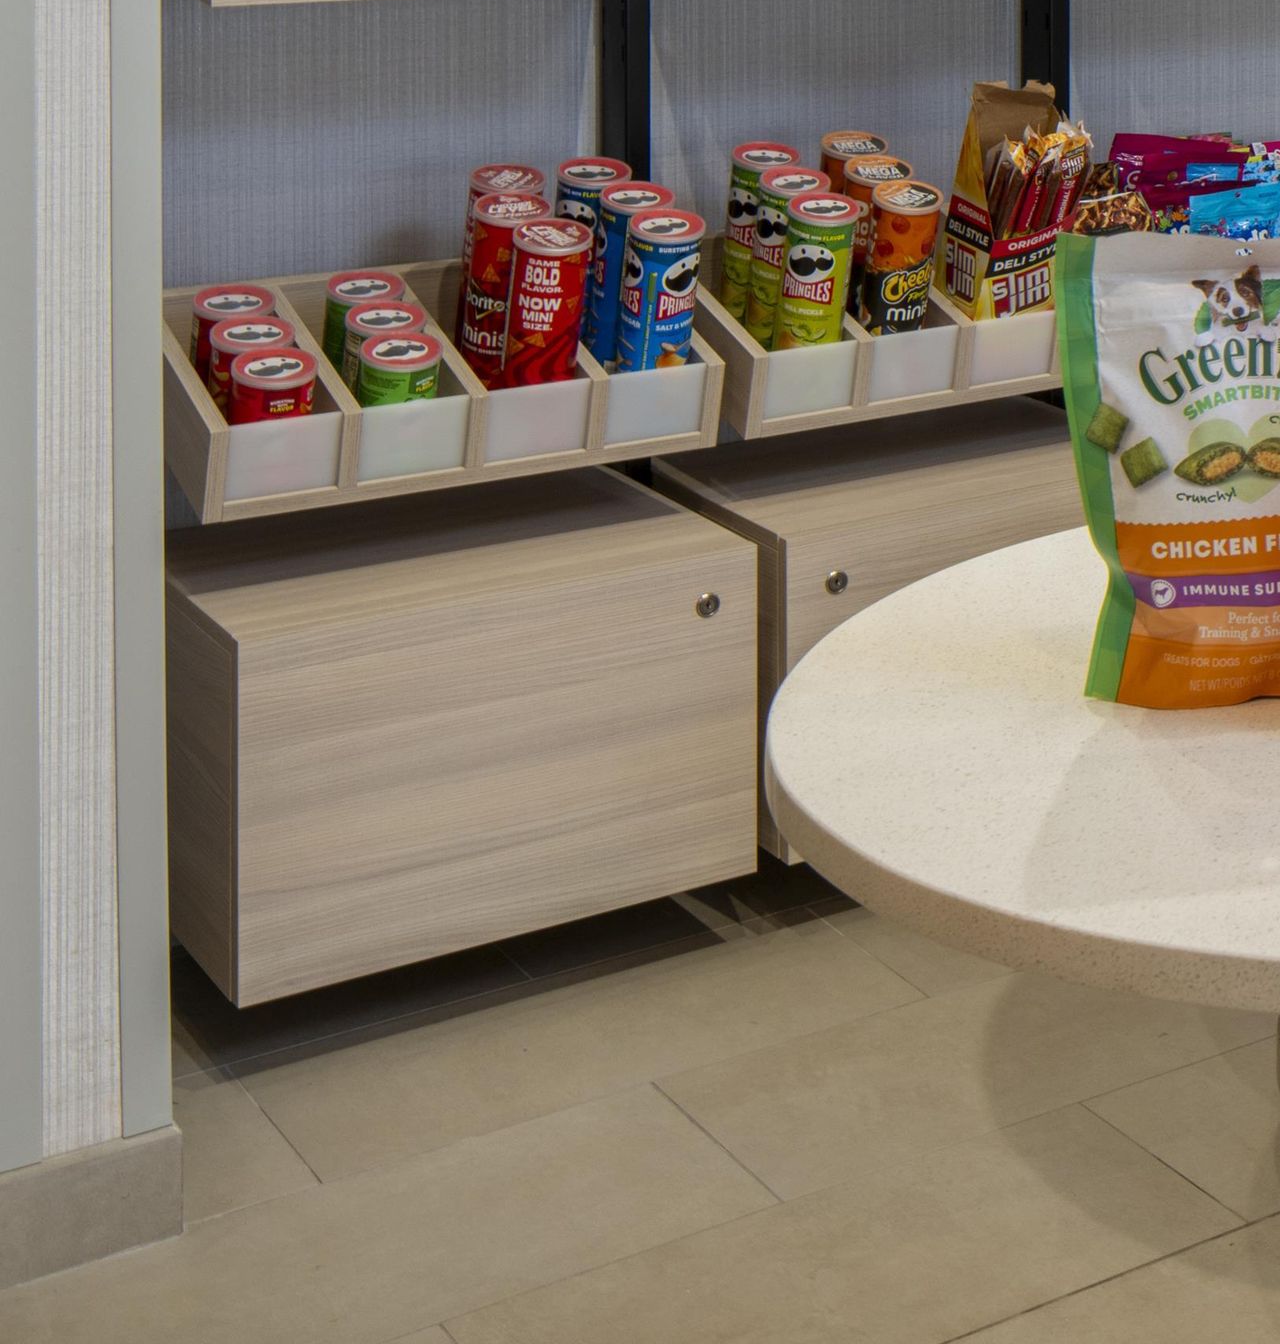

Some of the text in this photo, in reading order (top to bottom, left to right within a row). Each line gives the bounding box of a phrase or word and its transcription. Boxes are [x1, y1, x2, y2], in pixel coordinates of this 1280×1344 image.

[957, 202, 988, 225] ORIGINAL
[949, 218, 990, 247] DELI STYLE
[528, 258, 561, 267] SAME
[524, 264, 561, 287] BOLD
[783, 276, 832, 305] PRINGLES
[517, 293, 562, 311] NOW
[521, 310, 553, 323] MINI
[522, 321, 553, 332] SIZE.
[1151, 536, 1258, 560] CHICKEN
[1182, 584, 1250, 597] IMMUNE
[1227, 611, 1271, 625] Perfect
